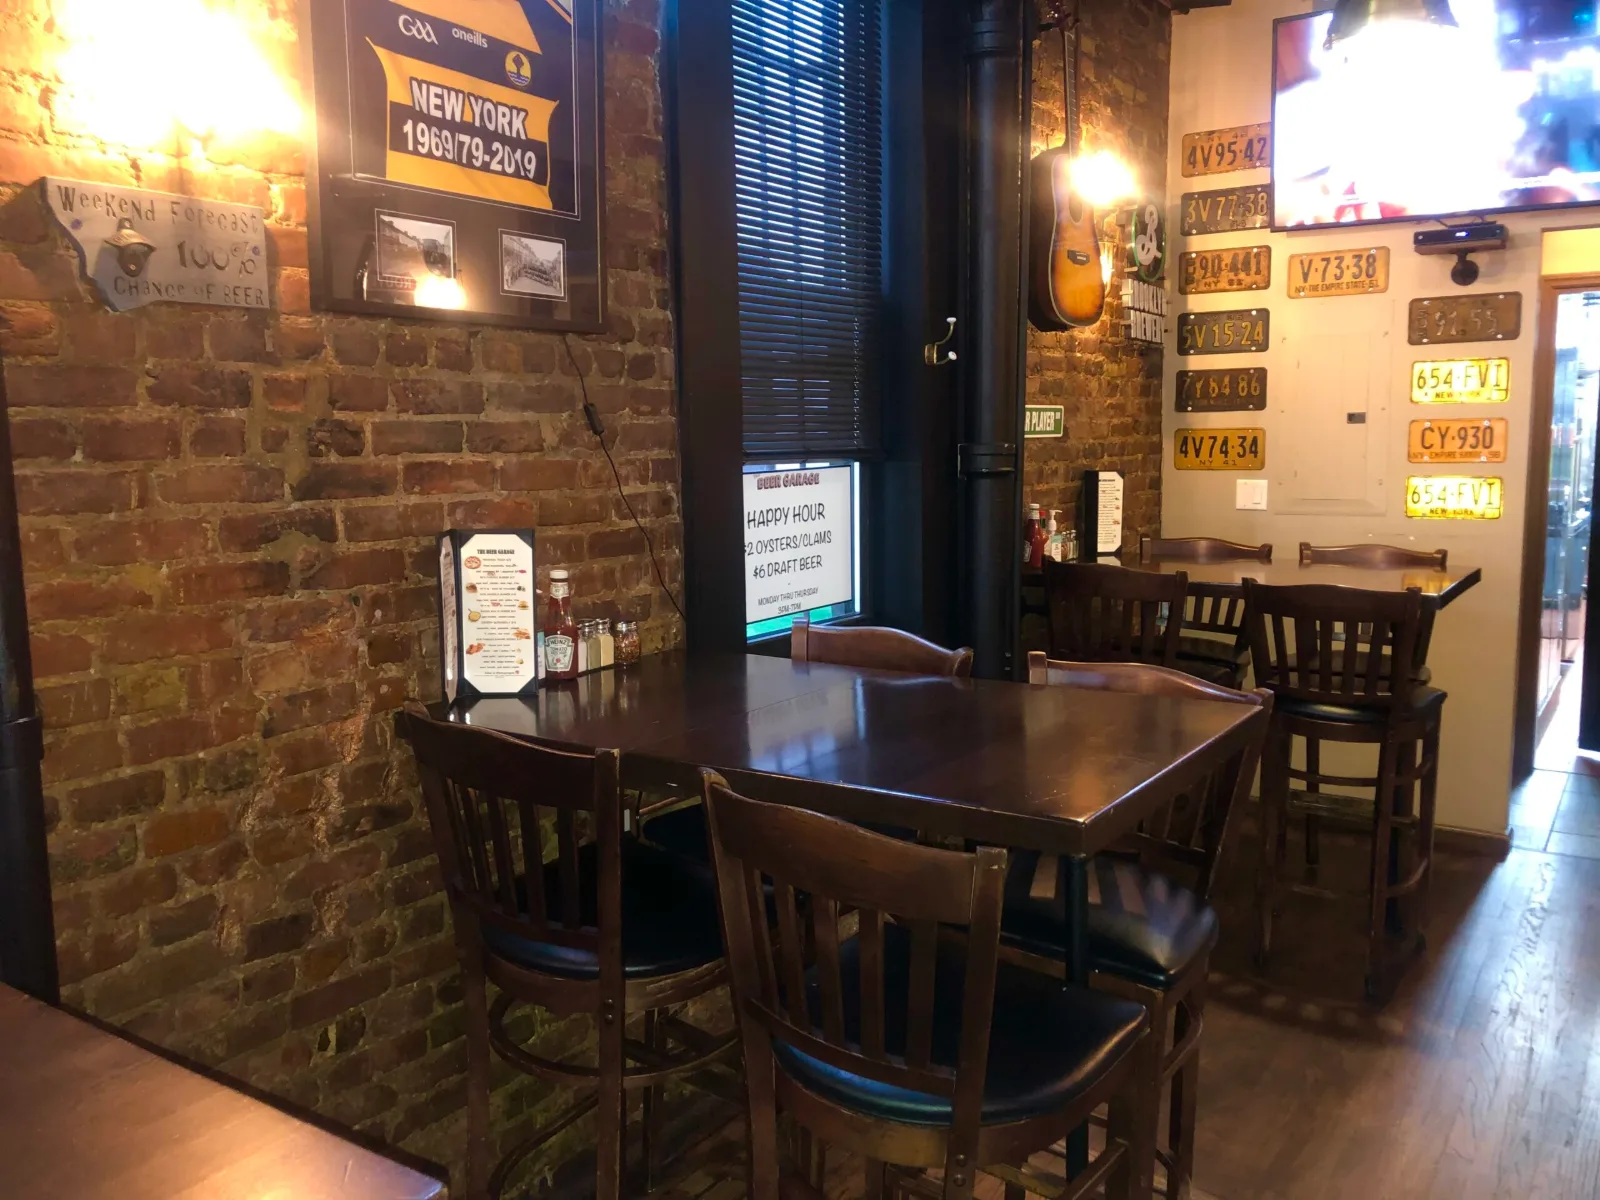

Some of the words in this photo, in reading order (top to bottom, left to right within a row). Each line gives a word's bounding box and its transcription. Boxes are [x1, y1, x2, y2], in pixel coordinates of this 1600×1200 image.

[451, 27, 488, 48] oneills
[411, 79, 464, 123] NEW
[468, 94, 527, 140] YORK
[402, 119, 537, 179] 1969/79-2019
[223, 285, 265, 306] BEER
[1321, 281, 1344, 291] EMPIRE
[1031, 411, 1055, 431] PLAYER
[757, 474, 782, 490] BEER
[783, 472, 820, 488] GARAGE
[747, 506, 790, 529] HAPPY
[792, 502, 826, 523] HOUR
[1429, 507, 1448, 515] NEW
[755, 530, 832, 554] OYSTERS/CLAMS
[752, 563, 766, 579] $6
[767, 558, 798, 577] DRAFT
[799, 554, 823, 571] BEER
[758, 594, 780, 606] MONDAY
[780, 592, 794, 601] THRU
[794, 587, 819, 599] THURSDAY
